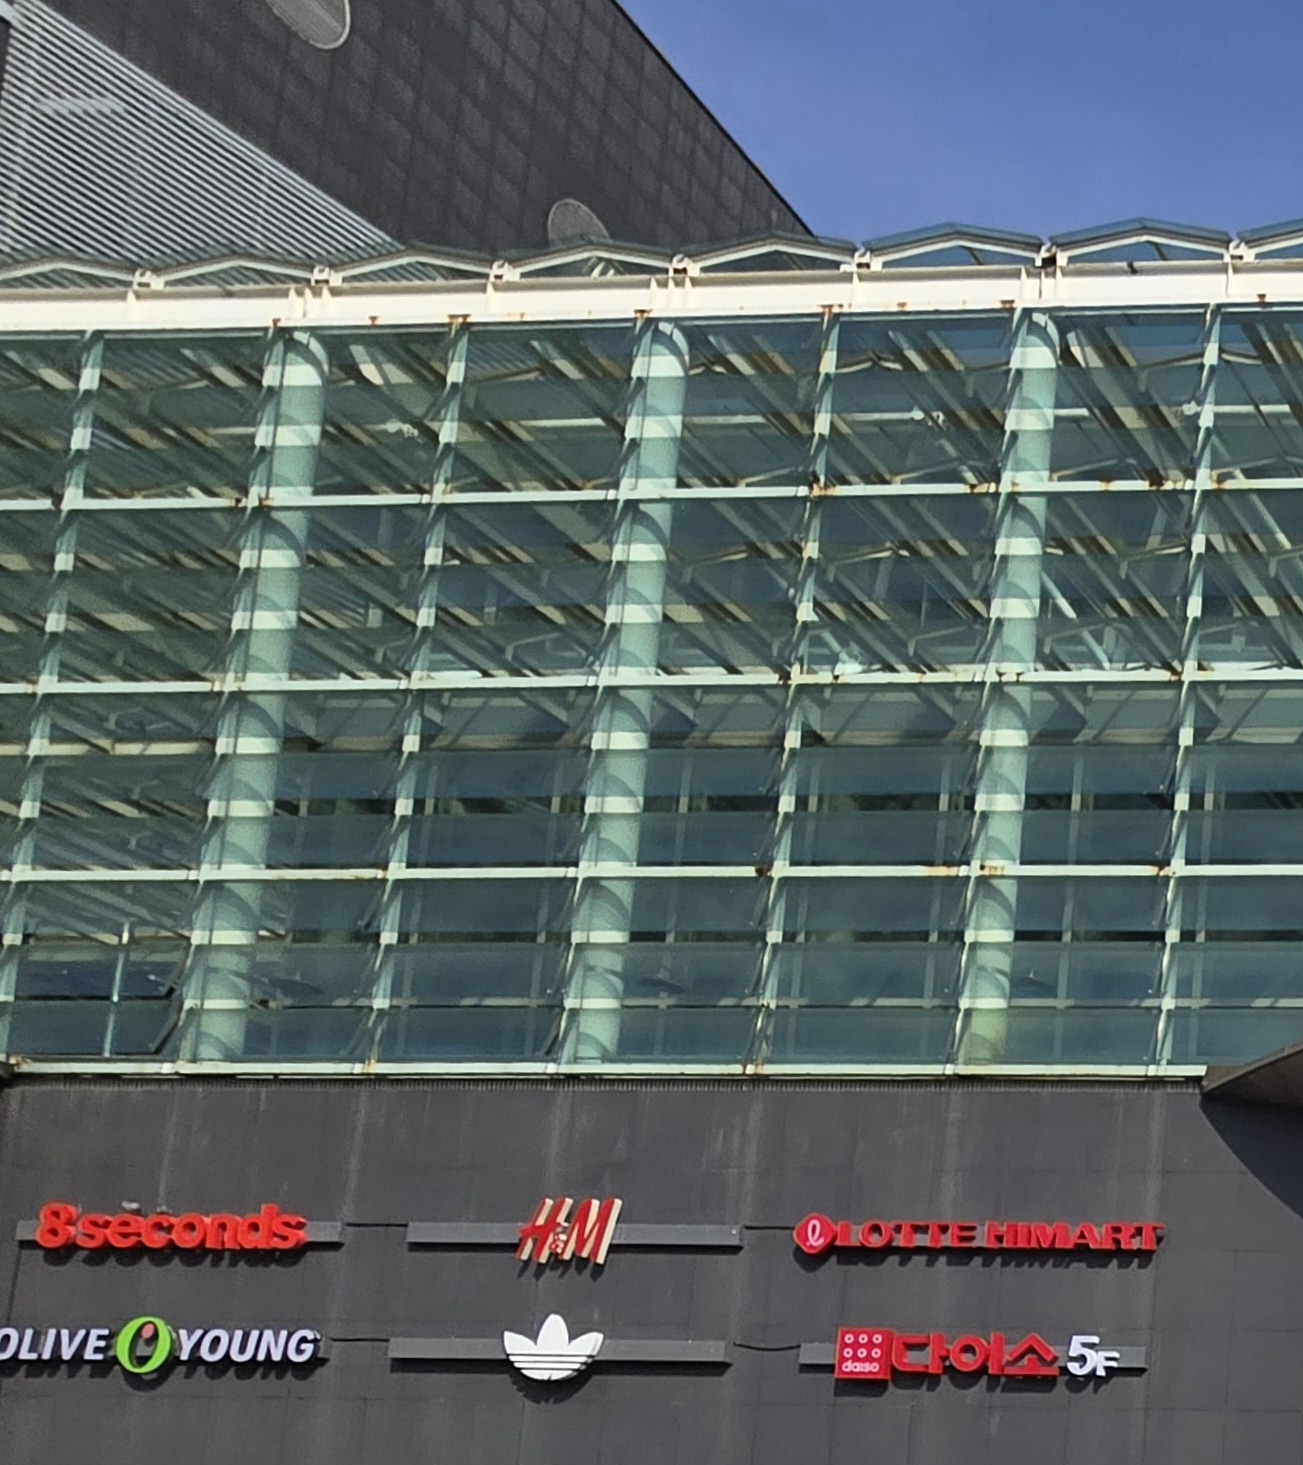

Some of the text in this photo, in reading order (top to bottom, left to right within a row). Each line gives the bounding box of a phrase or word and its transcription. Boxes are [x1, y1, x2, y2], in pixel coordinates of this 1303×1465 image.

[36, 1202, 307, 1250] 8seconds
[516, 1198, 622, 1265] H&M
[837, 1221, 1165, 1252] LOTTE HIMART
[0, 1327, 109, 1362] OLIVE
[178, 1328, 321, 1363] YOUNG
[892, 1332, 1120, 1378] 다이소 5F
